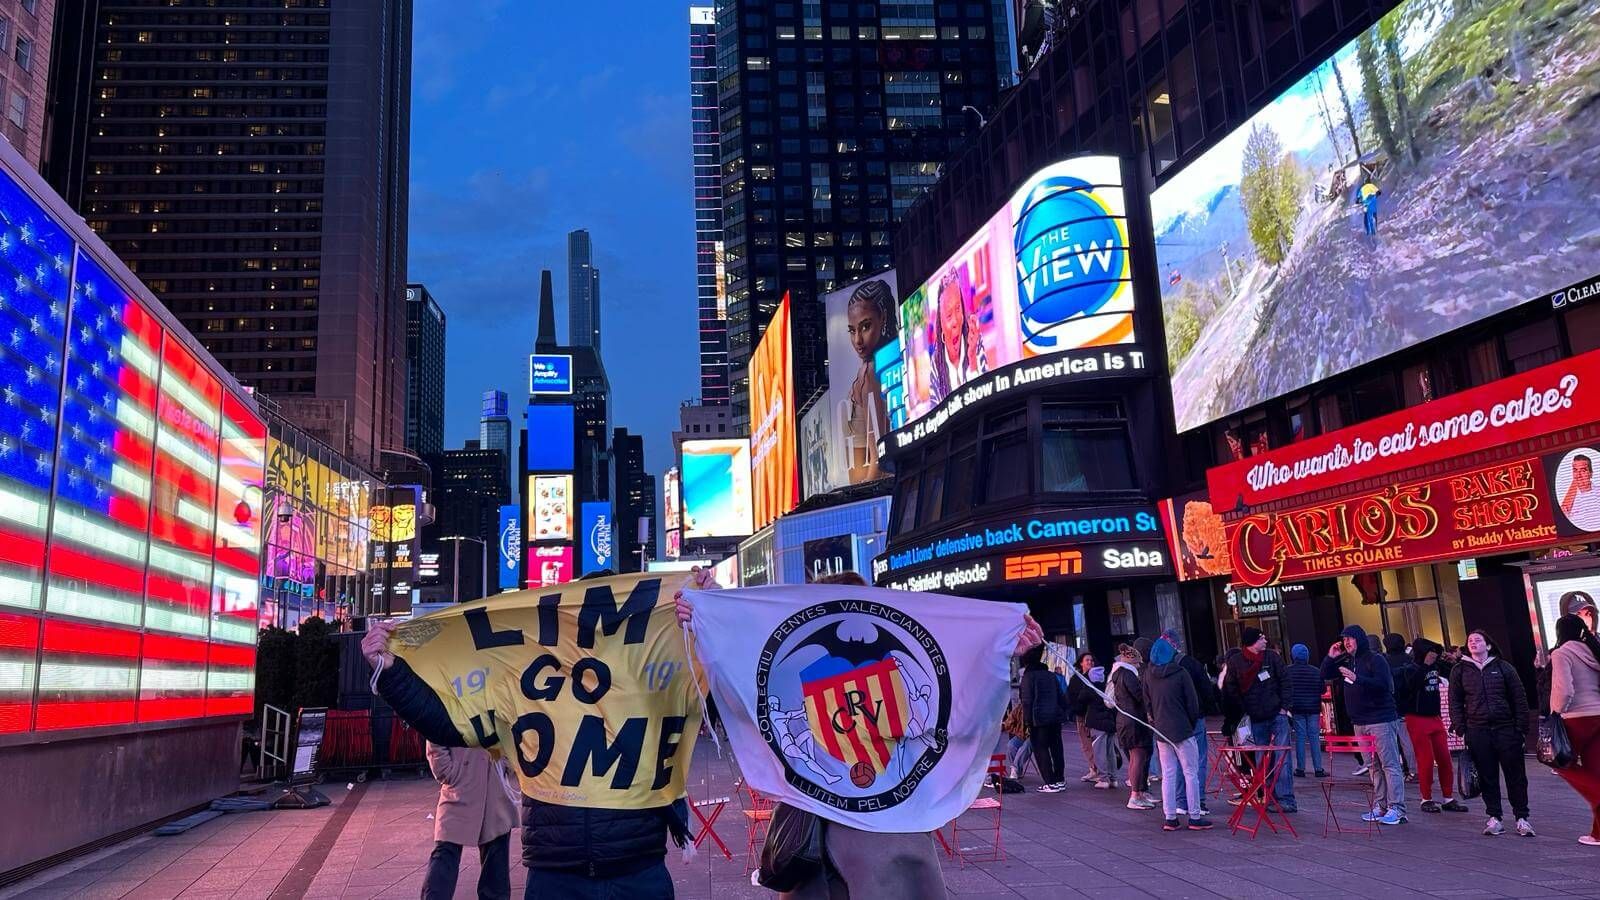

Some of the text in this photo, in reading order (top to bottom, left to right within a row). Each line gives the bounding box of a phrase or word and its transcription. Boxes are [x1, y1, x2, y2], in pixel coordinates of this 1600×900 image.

[1041, 226, 1071, 247] THE
[1017, 239, 1113, 304] VIEW
[534, 362, 546, 370] We
[534, 370, 558, 379] Amplify
[964, 382, 993, 406] show
[996, 374, 1010, 392] in
[1013, 356, 1098, 386] America
[1104, 352, 1125, 370] is
[1247, 373, 1579, 492] Who wants to eat some cake?
[1450, 461, 1535, 503] BAKE
[1453, 493, 1539, 531] SHOP
[936, 536, 983, 557] defensive
[986, 523, 1024, 546] back
[1027, 517, 1130, 539] Cameron
[1231, 483, 1439, 588] CARLO'S
[1452, 540, 1465, 550] BY
[1467, 531, 1504, 546] Buddy
[944, 561, 990, 590] episode'
[1006, 550, 1082, 580] ESPN
[1303, 546, 1403, 572] TIMES SQUARE
[463, 578, 662, 650] LIM
[774, 605, 827, 642] PENYES
[839, 601, 947, 676] VALENCIANISTES
[520, 653, 612, 704] GO
[791, 775, 849, 810] LLUITEM
[858, 798, 887, 811] PEL
[893, 757, 934, 802] NOSTRE
